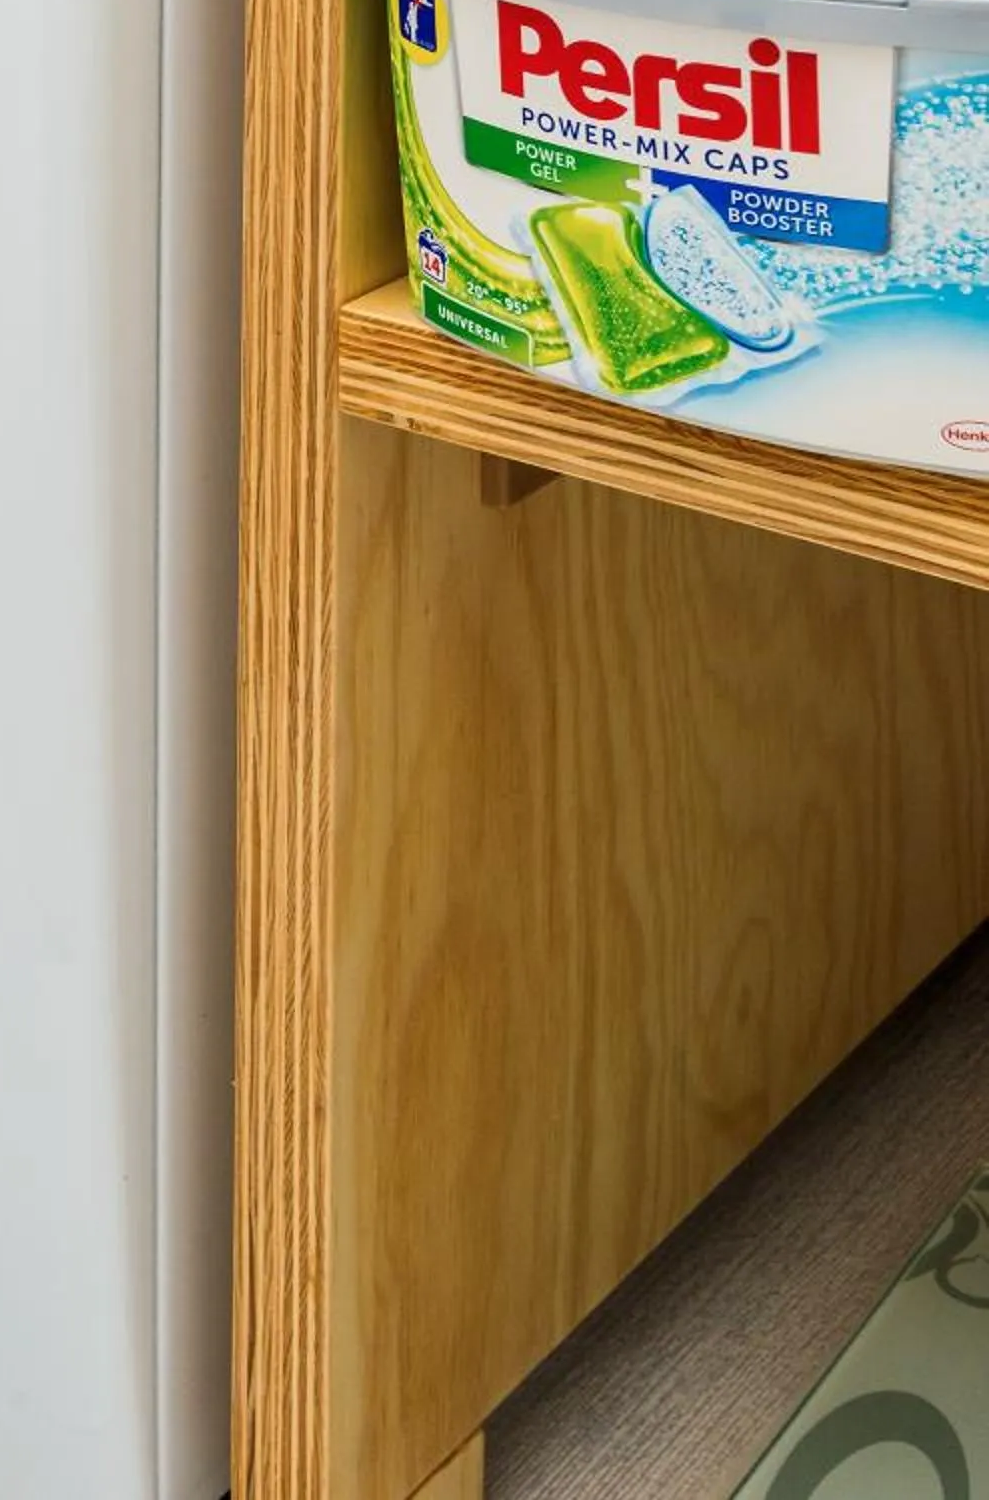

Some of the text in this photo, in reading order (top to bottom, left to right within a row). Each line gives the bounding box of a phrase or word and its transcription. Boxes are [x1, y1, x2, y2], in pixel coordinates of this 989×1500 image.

[514, 139, 578, 172] POWER
[521, 106, 791, 181] POWER-MIX CAPS
[529, 162, 563, 184] GEL
[729, 188, 830, 219] POWDER
[727, 206, 834, 238] BOOSTER
[423, 252, 441, 278] 14
[437, 303, 509, 349] UNIVERSAL
